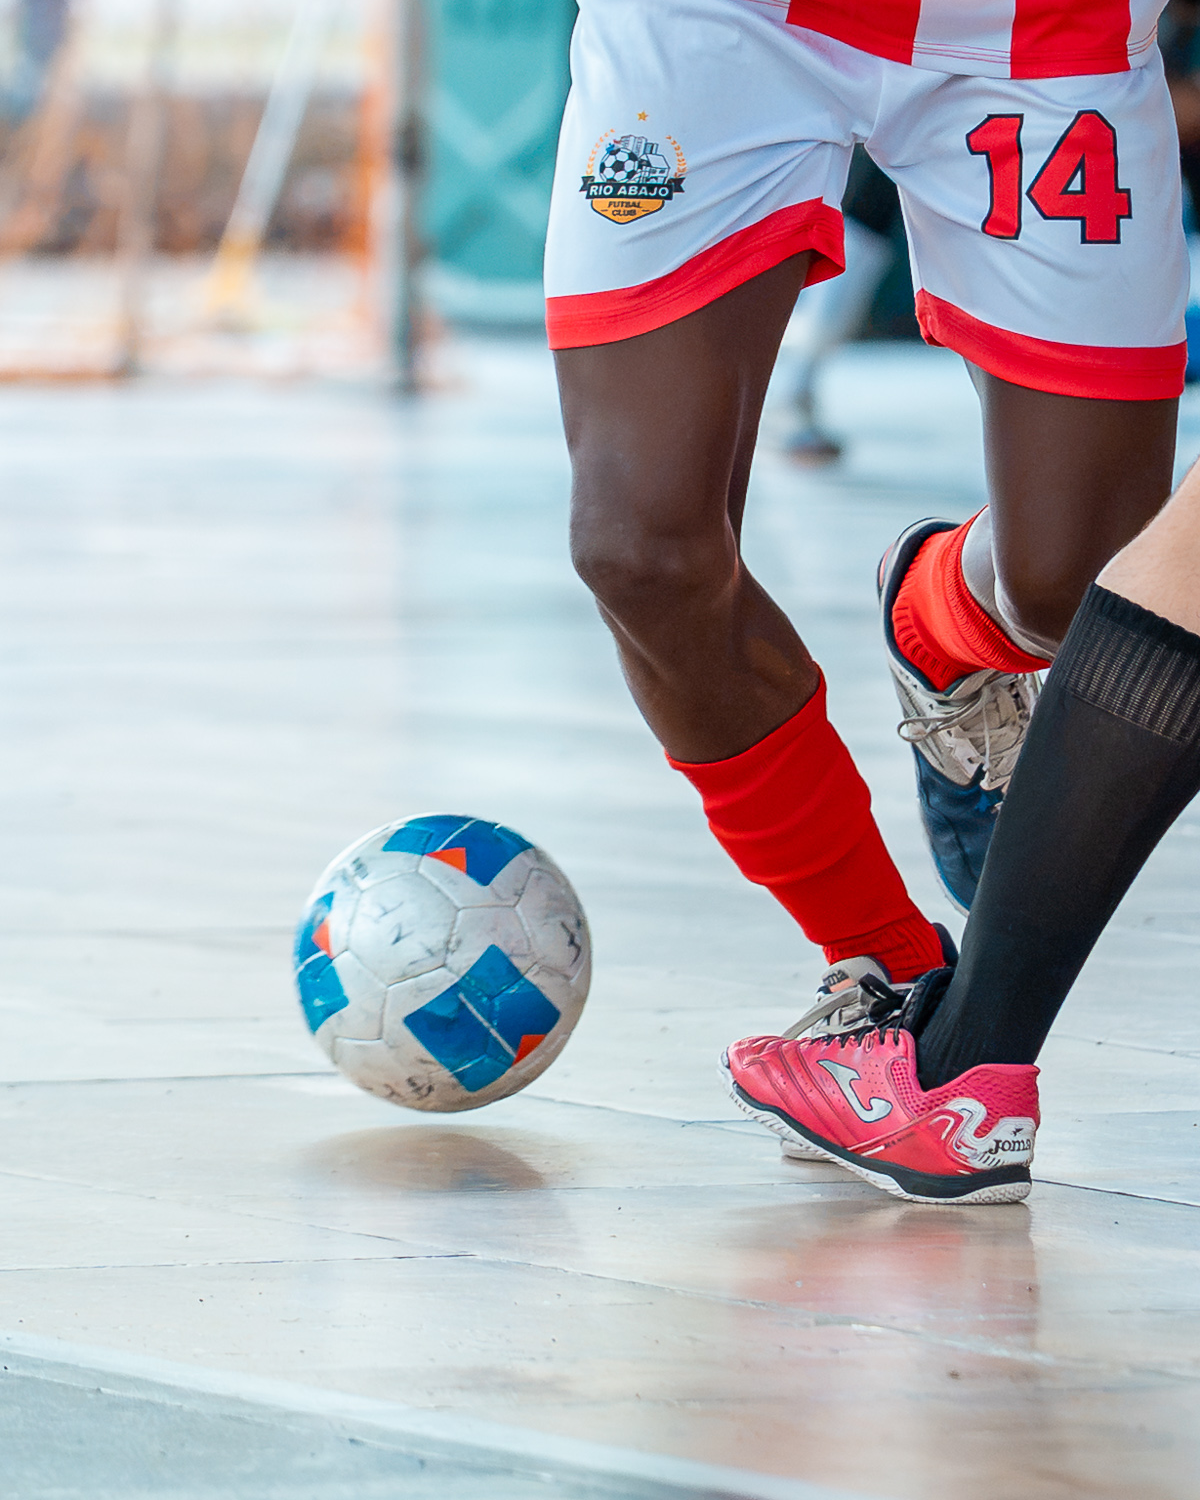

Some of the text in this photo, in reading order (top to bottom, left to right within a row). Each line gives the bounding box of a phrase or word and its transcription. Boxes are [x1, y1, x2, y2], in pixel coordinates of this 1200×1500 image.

[965, 109, 1132, 244] 14
[589, 185, 670, 198] RIO ABAJO
[611, 209, 637, 217] CLUB
[988, 1138, 1031, 1155] Joma
